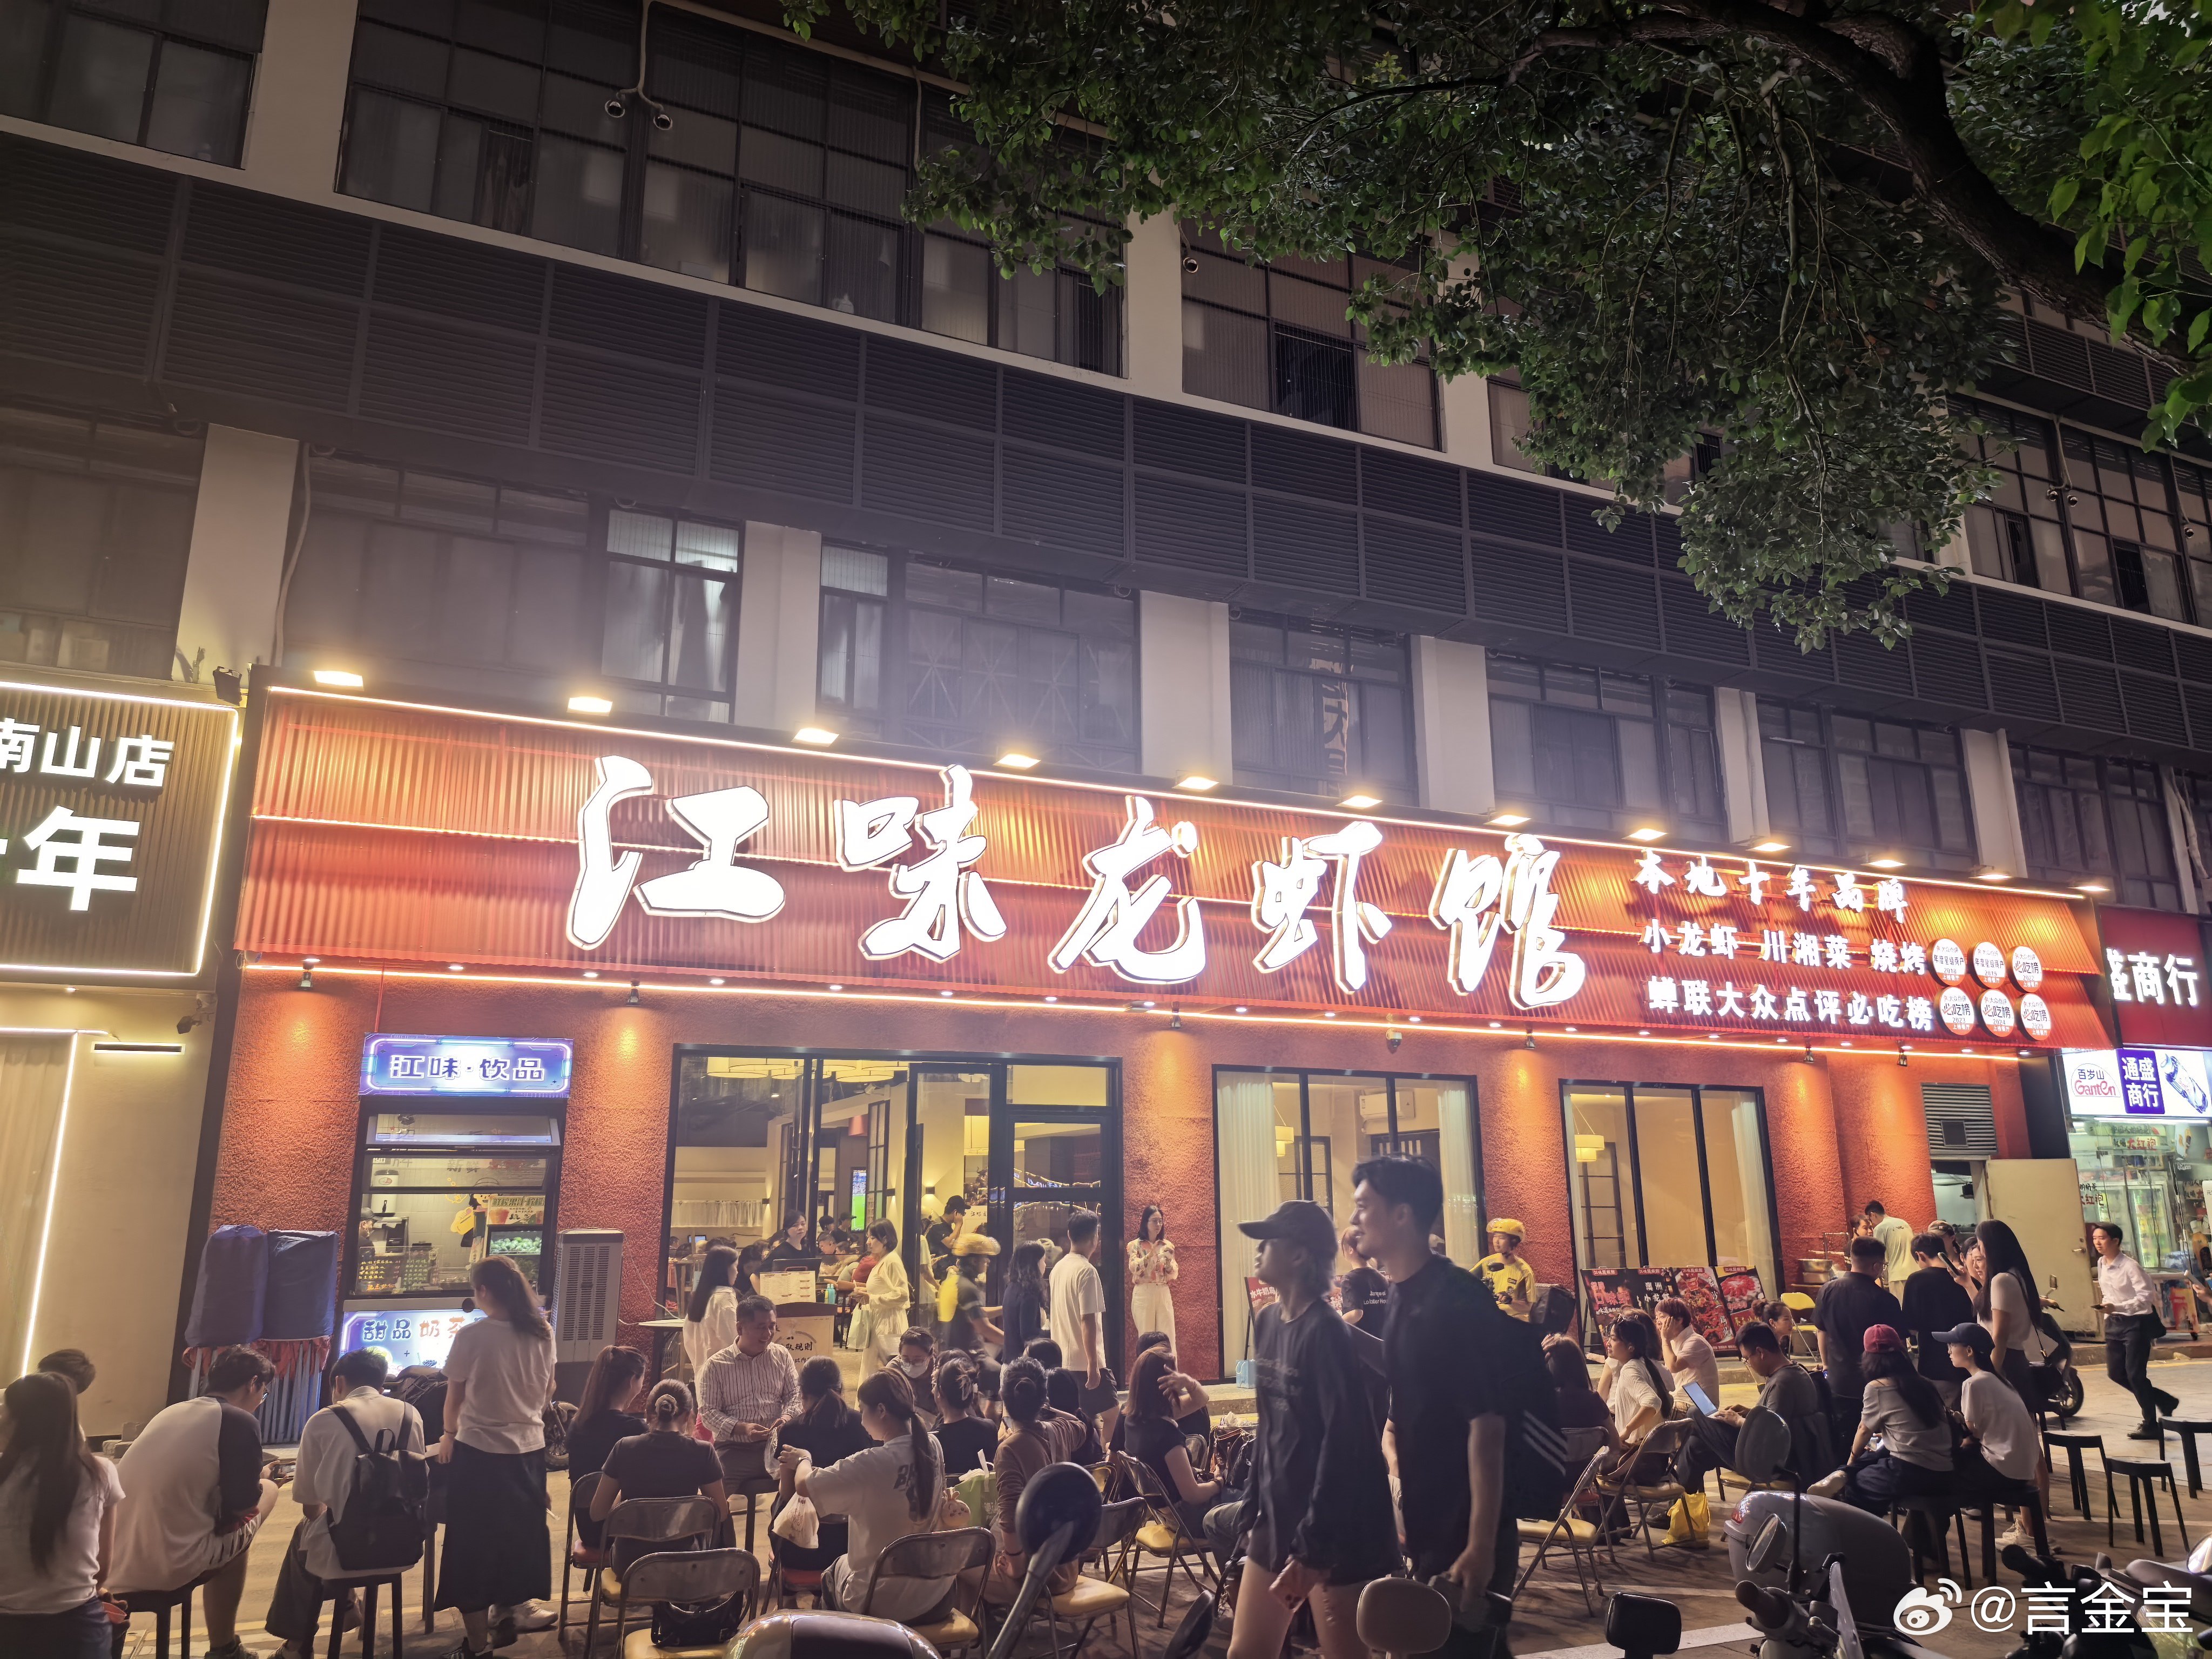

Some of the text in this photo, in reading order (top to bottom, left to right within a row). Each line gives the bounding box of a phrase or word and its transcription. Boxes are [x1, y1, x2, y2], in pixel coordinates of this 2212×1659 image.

[0, 717, 174, 787] 南山店
[0, 805, 140, 911] 年
[566, 754, 1586, 1010] 江味龙虾馆
[1633, 848, 1907, 923] 本地十年品牌
[1640, 918, 1926, 975] 小龙虾 川湘菜 烧烤
[1647, 975, 1933, 1032] 蝉联大众点评必吃榜
[1942, 1003, 1971, 1016] 必吃榜
[1982, 1004, 2011, 1019] 必吃榜
[2078, 1069, 2105, 1080] 百岁山
[2122, 1057, 2156, 1081] 通盛
[2126, 1082, 2159, 1107] 商行
[363, 1316, 488, 1340] 甜品奶茶
